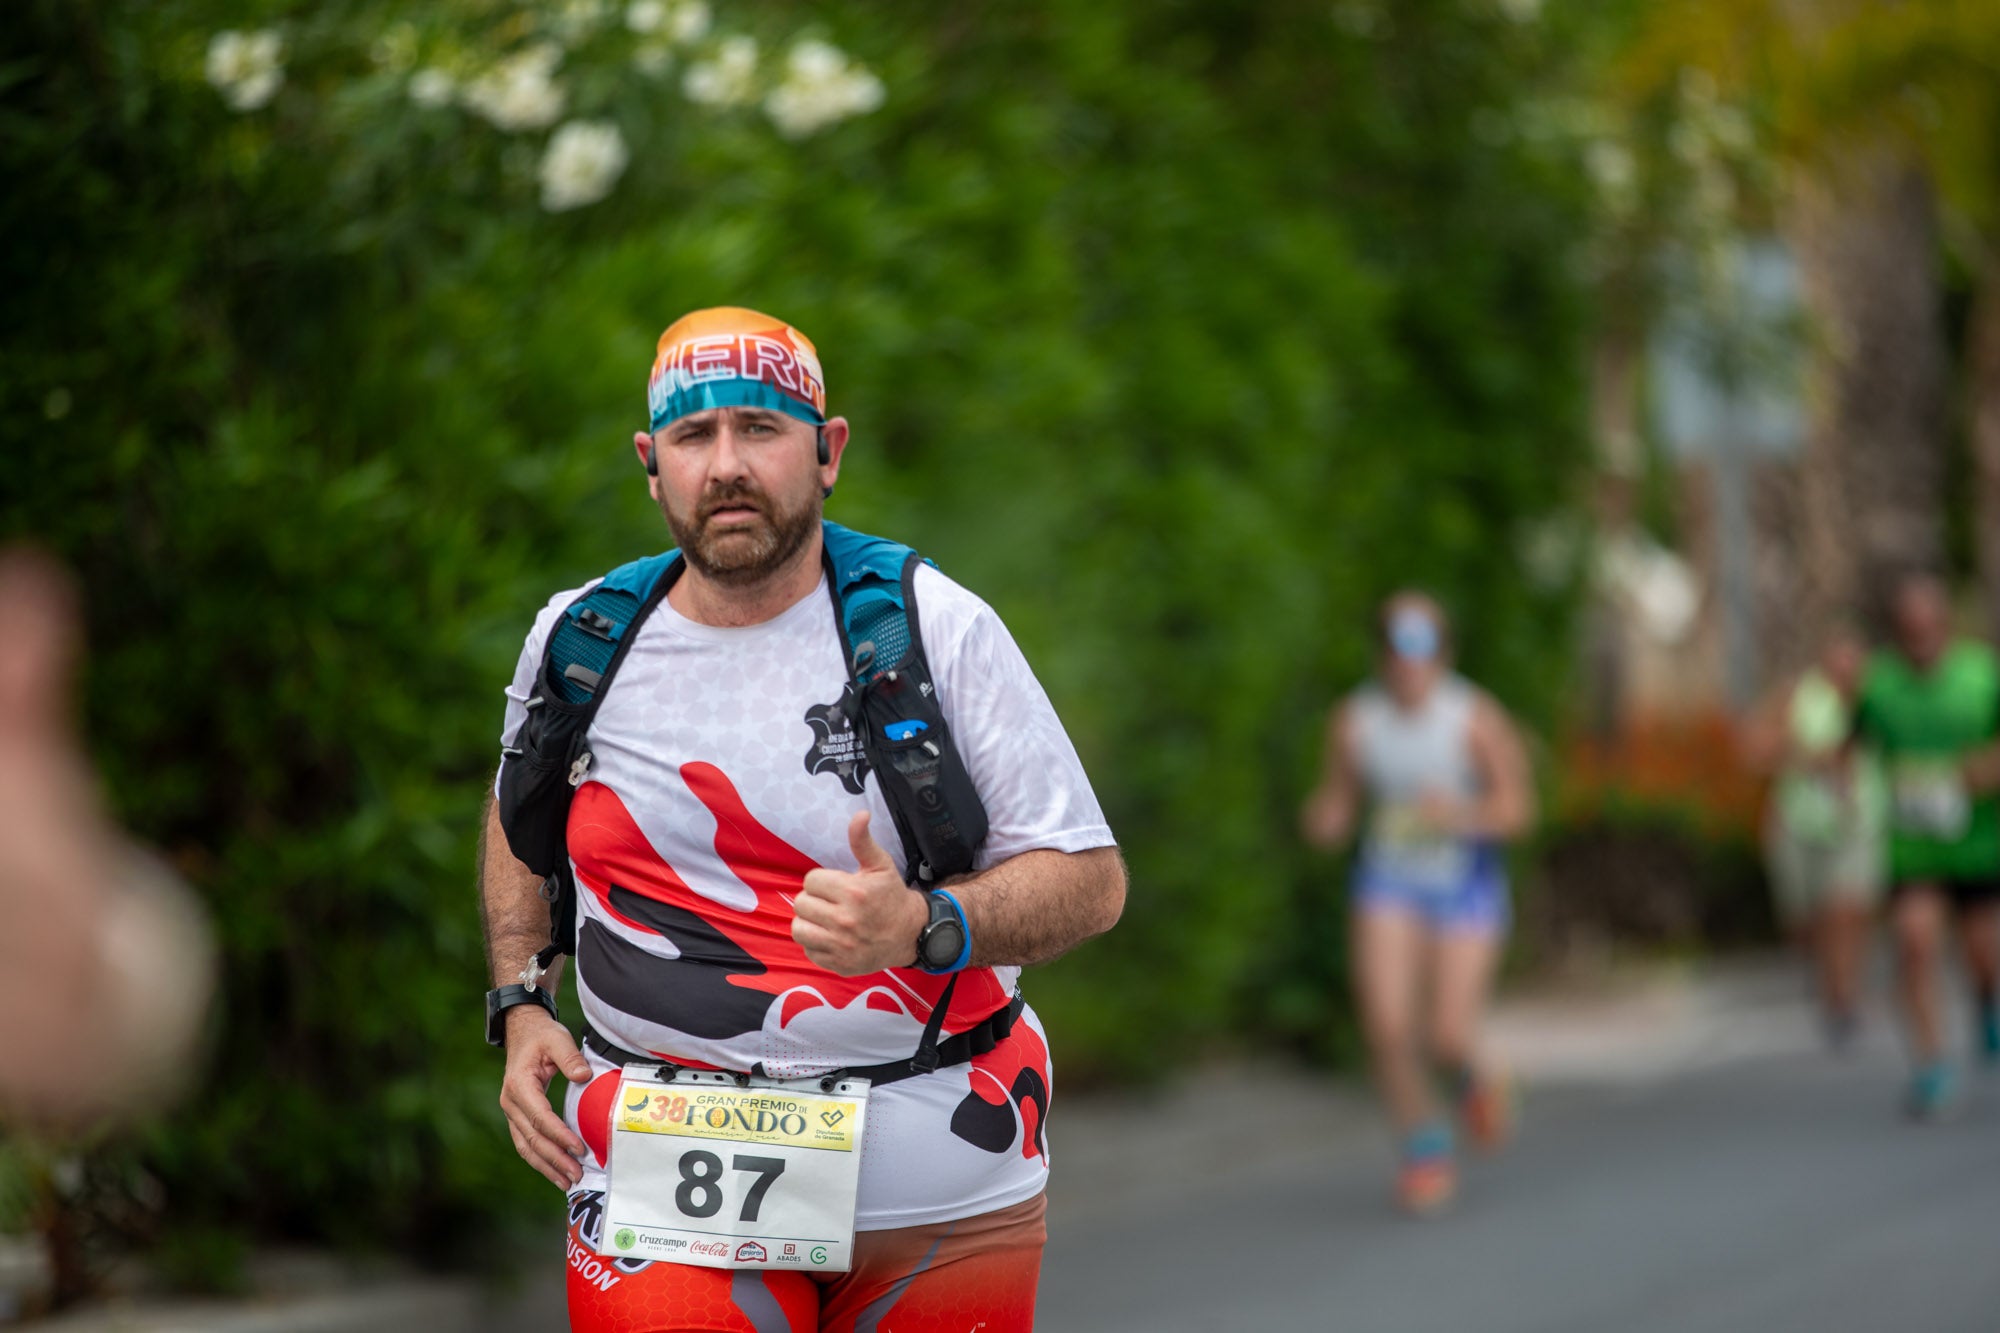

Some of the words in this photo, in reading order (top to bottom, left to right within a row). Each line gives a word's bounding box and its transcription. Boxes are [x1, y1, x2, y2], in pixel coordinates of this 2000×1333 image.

[821, 743, 846, 755] CIUDAD
[649, 1095, 688, 1123] 38
[696, 1095, 740, 1107] GRAN
[740, 1098, 797, 1113] PREMIO
[799, 1105, 808, 1114] DE
[685, 1105, 806, 1136] FONDO
[675, 1150, 786, 1223] 87
[639, 1234, 687, 1249] Cruzcampo
[776, 1255, 801, 1263] ABADES
